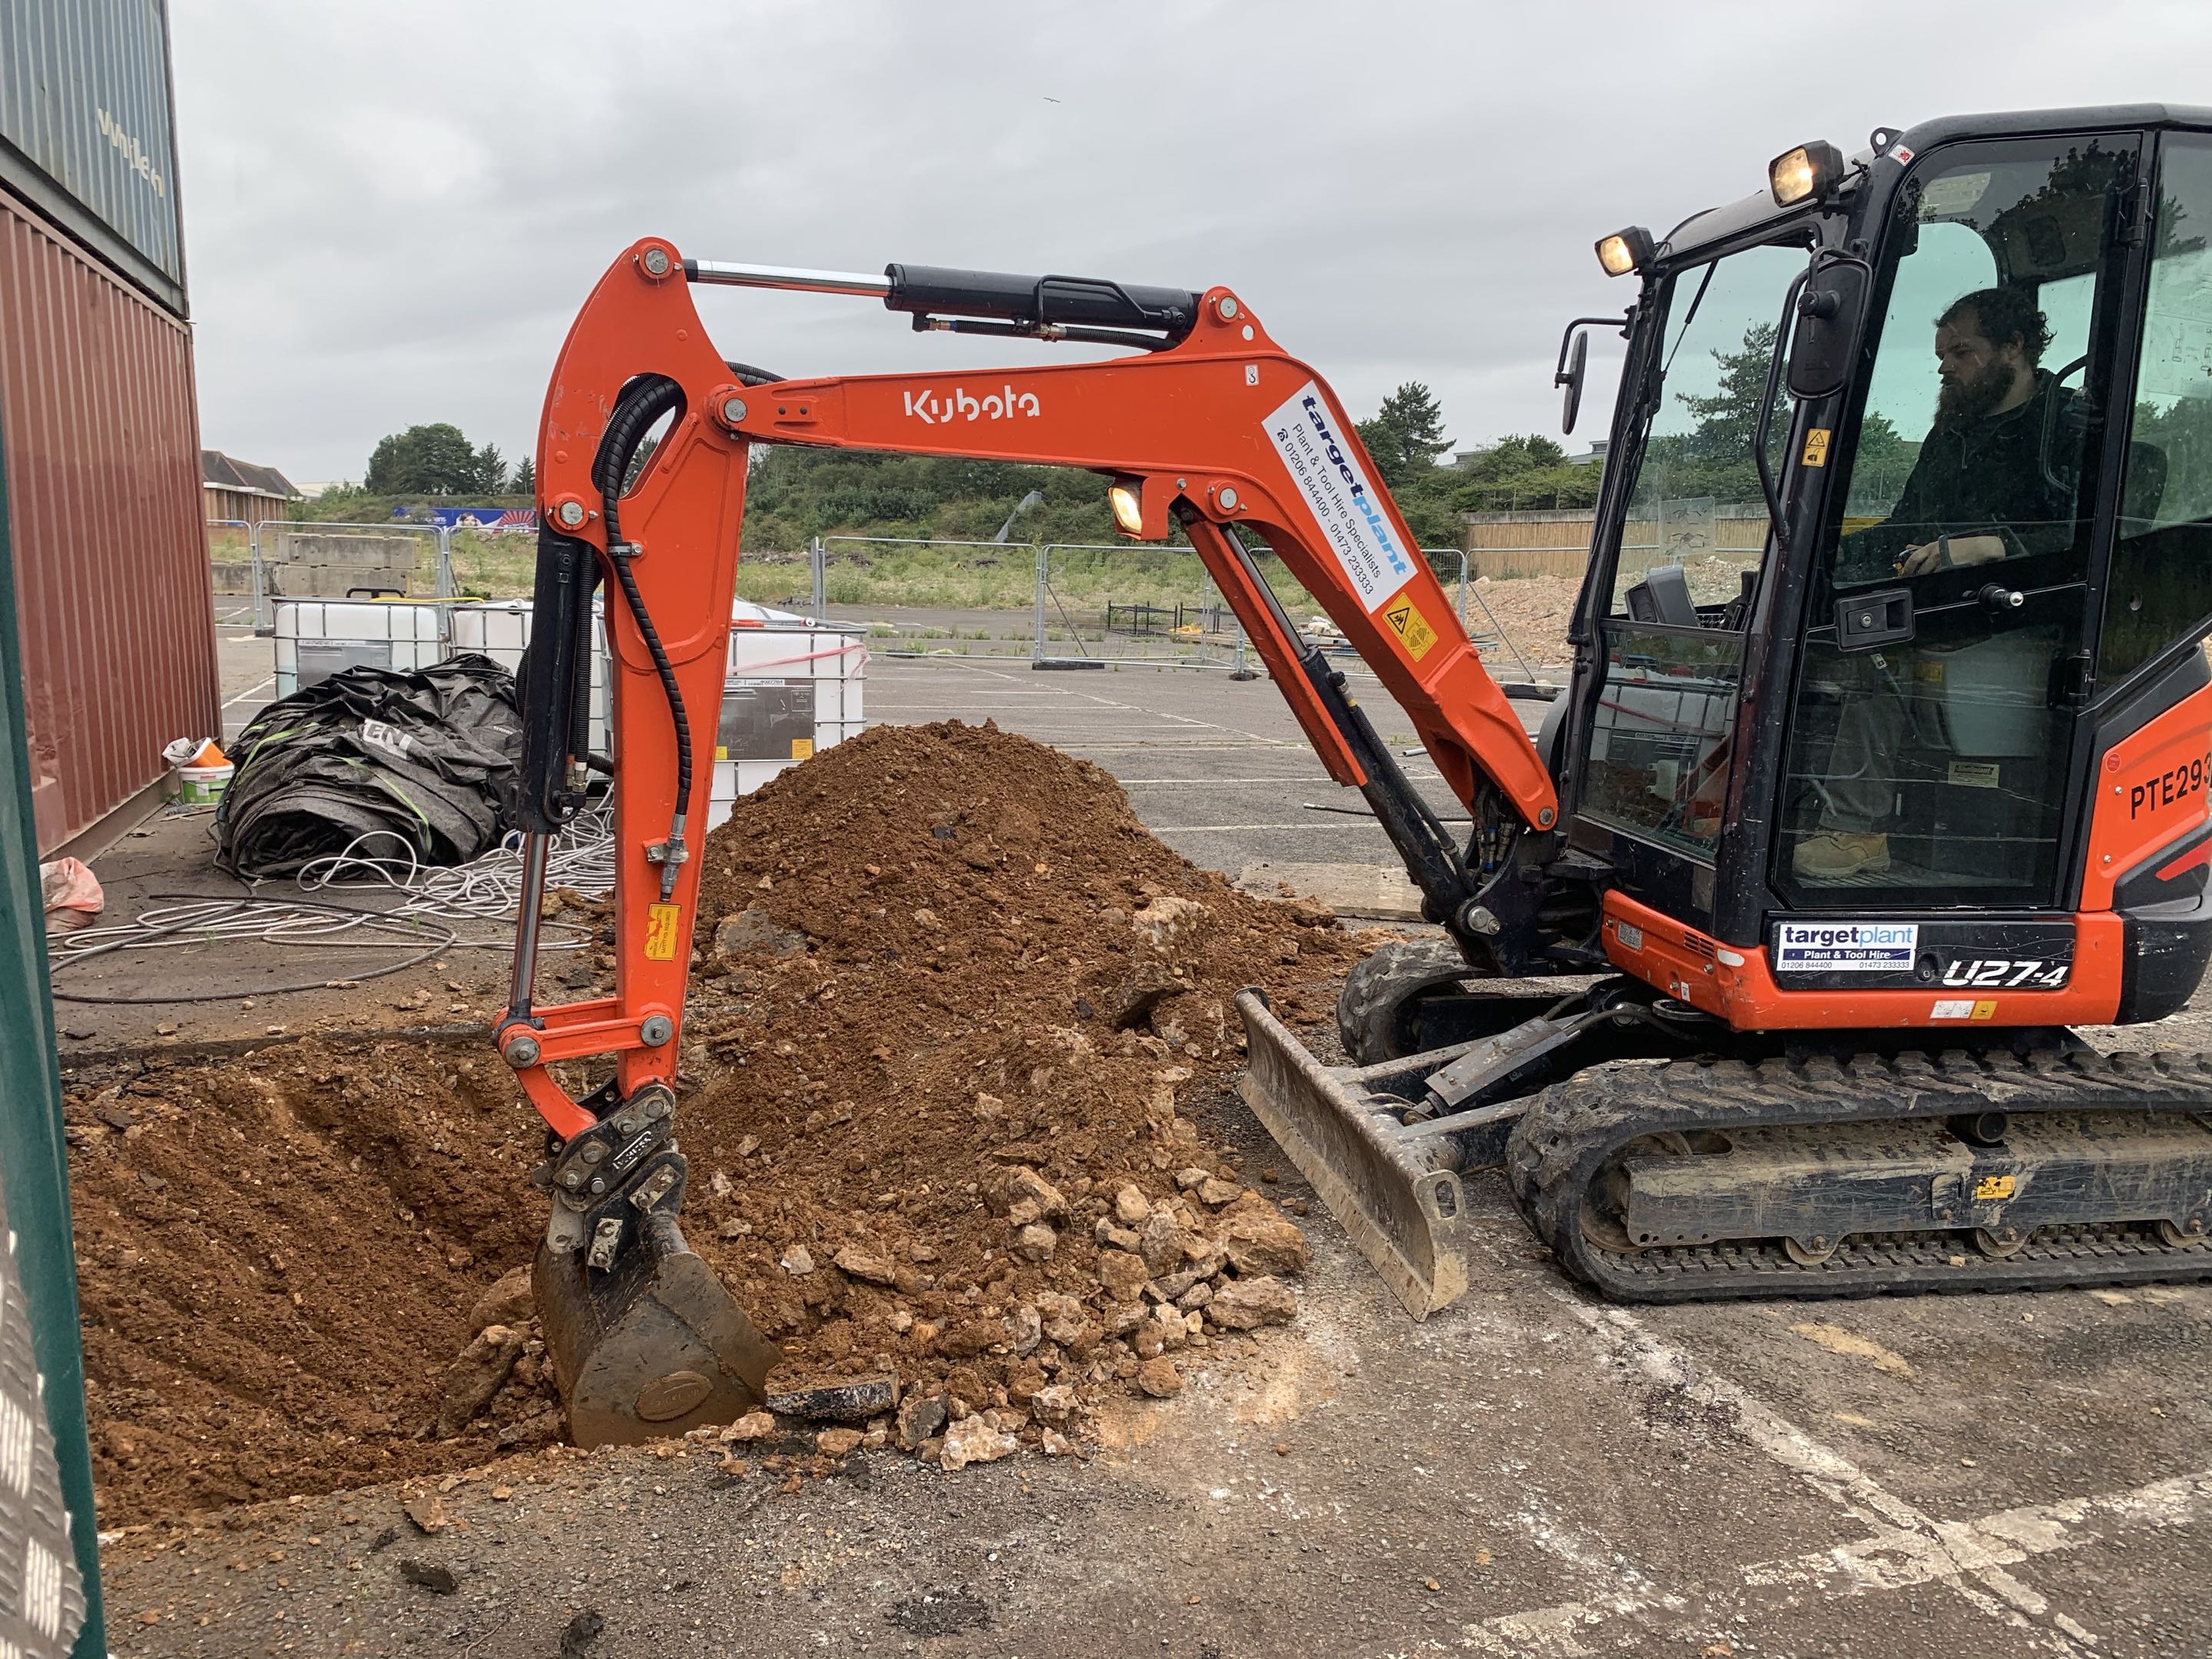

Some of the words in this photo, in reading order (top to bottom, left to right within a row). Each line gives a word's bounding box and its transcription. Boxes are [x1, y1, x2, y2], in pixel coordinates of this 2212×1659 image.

[903, 385, 1040, 424] Kubota
[1293, 423, 1313, 456] Plant
[1310, 455, 1320, 467] &
[1317, 465, 1336, 495] Tool
[1331, 493, 1347, 519] Hire
[1346, 518, 1381, 578] Specialists
[1302, 396, 1407, 575] targetplant
[1285, 442, 1307, 476] 01206
[1303, 476, 1330, 517] 844400
[1330, 523, 1352, 555] 01473
[1348, 555, 1373, 594] 233333
[1785, 926, 1912, 947] targetplant
[1804, 950, 1831, 959] Plant
[1844, 950, 1866, 959] Tool
[1942, 960, 2068, 986] U27-4
